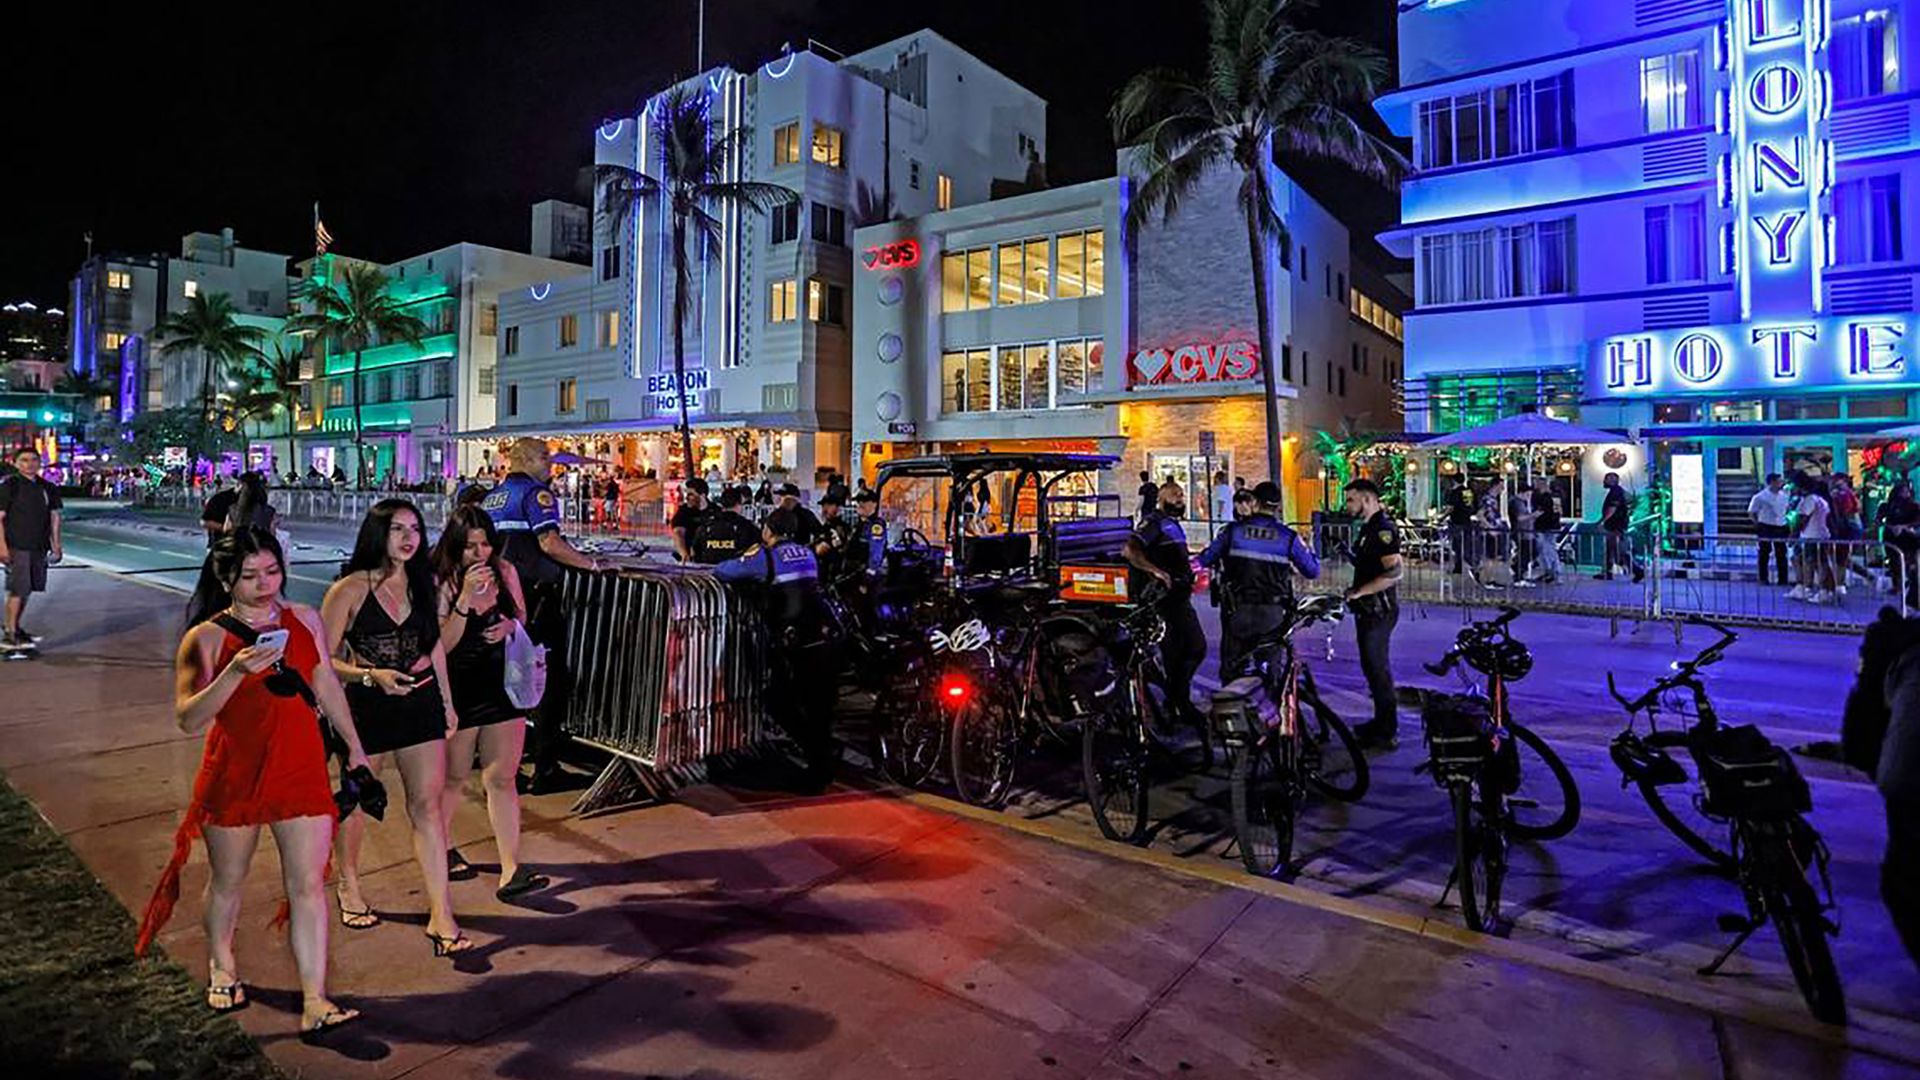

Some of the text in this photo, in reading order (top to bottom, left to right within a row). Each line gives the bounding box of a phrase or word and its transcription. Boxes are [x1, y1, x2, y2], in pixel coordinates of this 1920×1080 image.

[880, 242, 916, 266] CVS
[1171, 342, 1258, 380] CVS
[1606, 322, 1905, 389] HOTE
[648, 370, 708, 392] BEAON
[706, 539, 736, 549] POLICE
